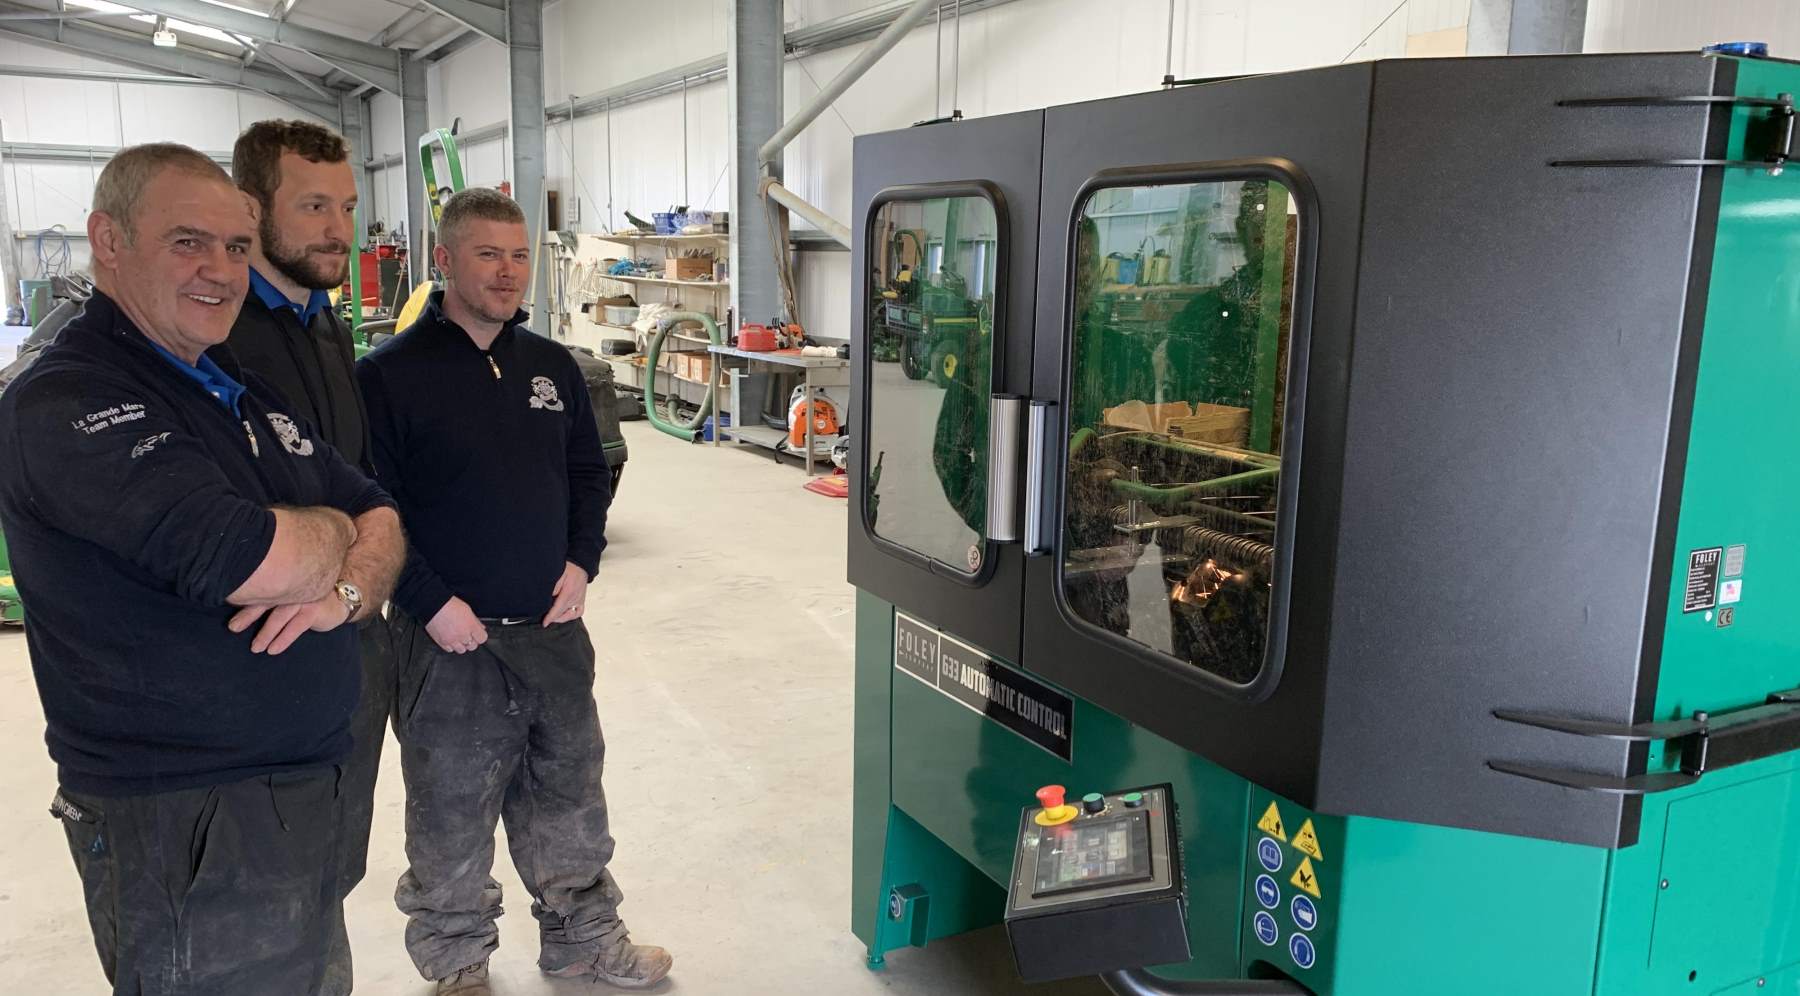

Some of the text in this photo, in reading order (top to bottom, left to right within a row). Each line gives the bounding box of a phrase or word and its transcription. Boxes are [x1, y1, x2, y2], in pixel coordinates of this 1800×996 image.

[71, 419, 86, 430] La
[87, 407, 120, 421] Grande
[82, 411, 145, 434] Team Member
[1695, 552, 1717, 563] FOLEY
[899, 628, 937, 664] FOLEY
[942, 653, 1067, 740] 633 AUTOMATIC CONTROL
